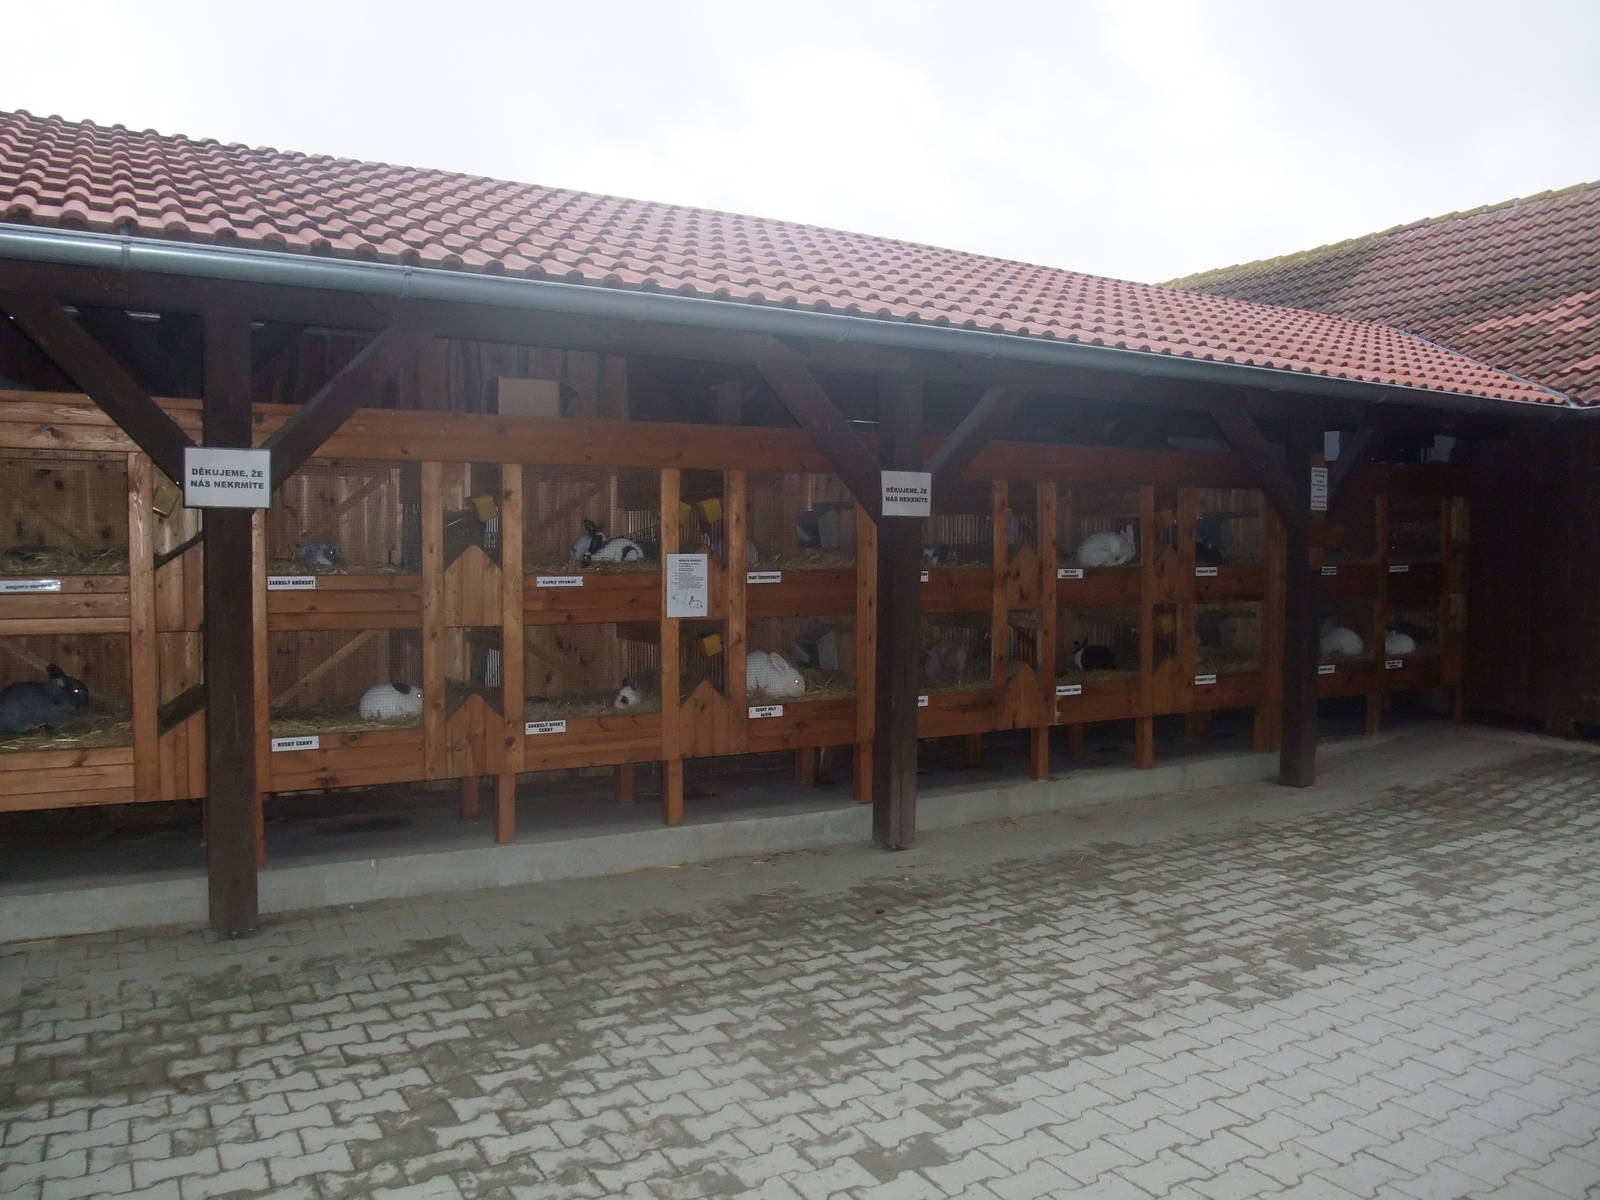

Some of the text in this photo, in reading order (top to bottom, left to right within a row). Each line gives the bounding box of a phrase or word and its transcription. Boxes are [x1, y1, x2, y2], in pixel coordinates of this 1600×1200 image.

[191, 467, 264, 478] DĚKUJEME, ŽE
[190, 479, 211, 488] NÁS
